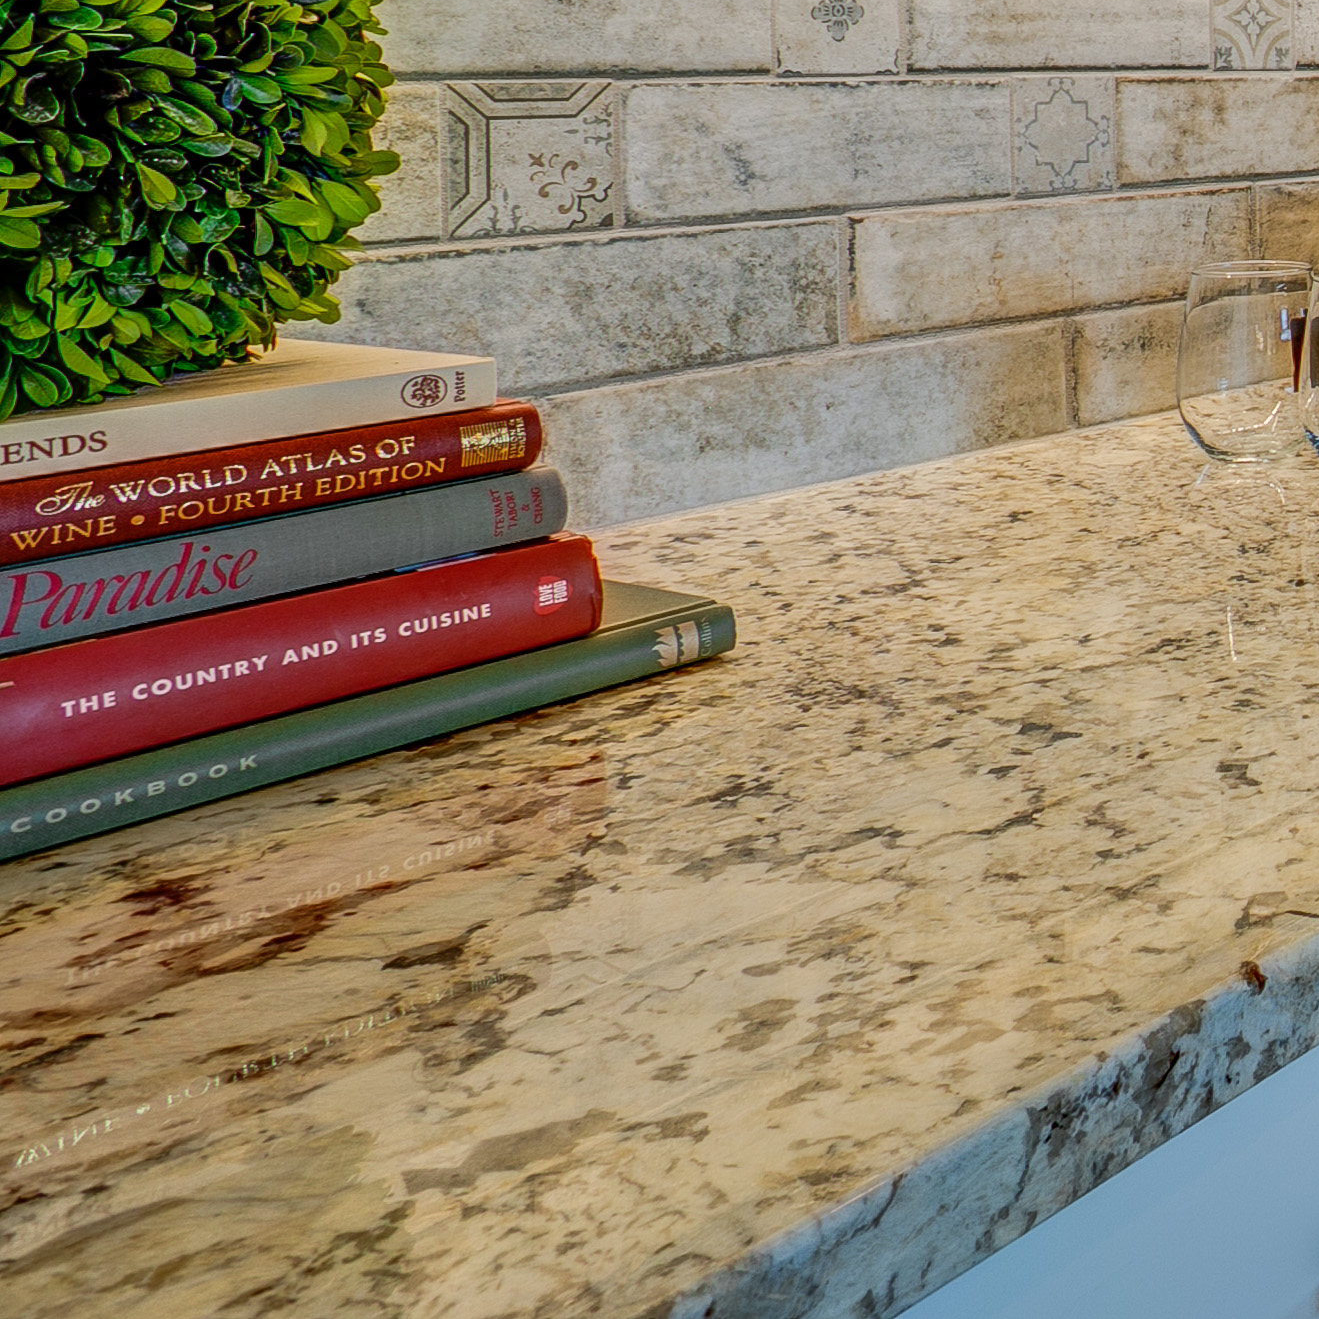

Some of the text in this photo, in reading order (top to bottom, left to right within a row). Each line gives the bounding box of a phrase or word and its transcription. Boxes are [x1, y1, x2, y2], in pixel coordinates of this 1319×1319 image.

[454, 370, 466, 403] Potter
[0, 430, 108, 465] ENDS
[35, 435, 416, 516] The WORLD ATLAS OF
[9, 457, 447, 551] WINE FOURTH EDITION
[489, 489, 504, 538] STEWART
[504, 490, 518, 530] TABORI
[520, 503, 530, 512] &
[530, 486, 543, 525] CHANG
[0, 541, 258, 638] Paradise
[538, 583, 553, 607] LOVE
[553, 579, 568, 605] FOOD
[701, 615, 713, 657] Collins
[61, 602, 492, 718] THE COUNTRY AND ITS CUISINE
[10, 754, 258, 833] COOKBOOK
